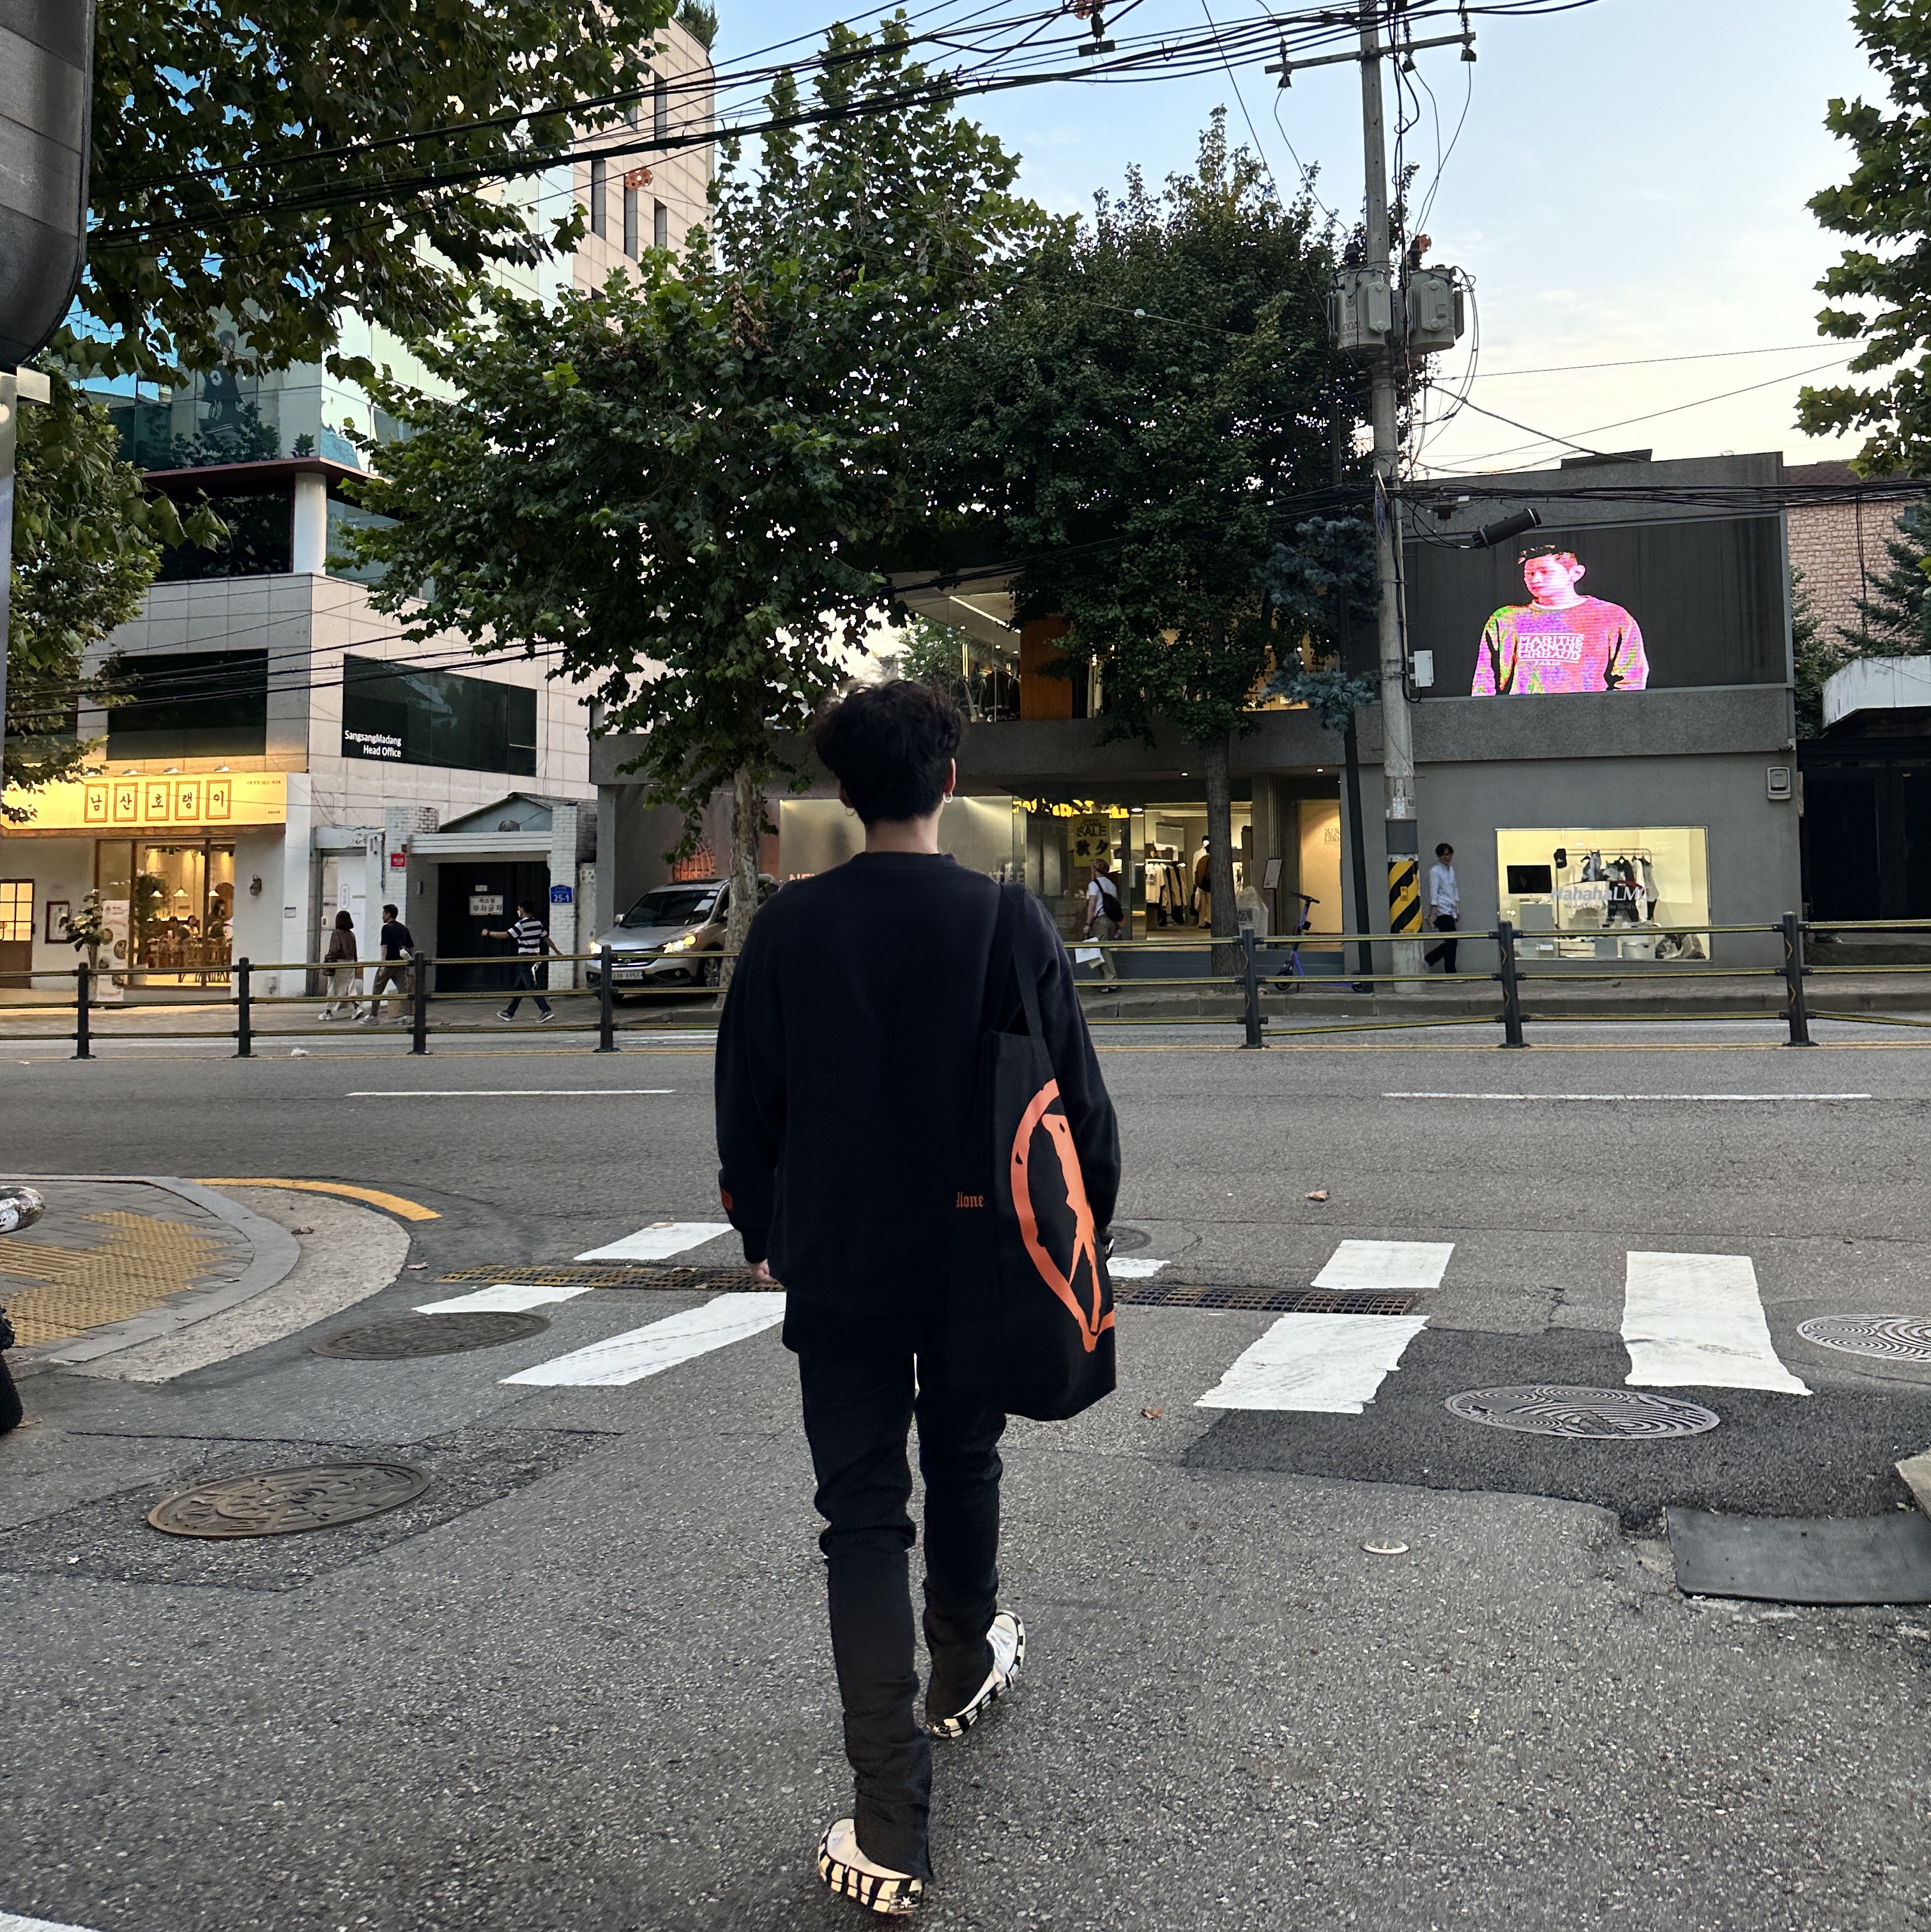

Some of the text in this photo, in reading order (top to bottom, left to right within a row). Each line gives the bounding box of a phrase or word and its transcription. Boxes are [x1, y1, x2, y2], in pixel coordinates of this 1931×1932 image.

[1518, 650, 1582, 660] GIRBAUD
[345, 730, 401, 747] SangsangMadang
[363, 745, 401, 757] Head Office
[91, 791, 224, 810] 남산호랭이
[1076, 826, 1106, 837] SALE
